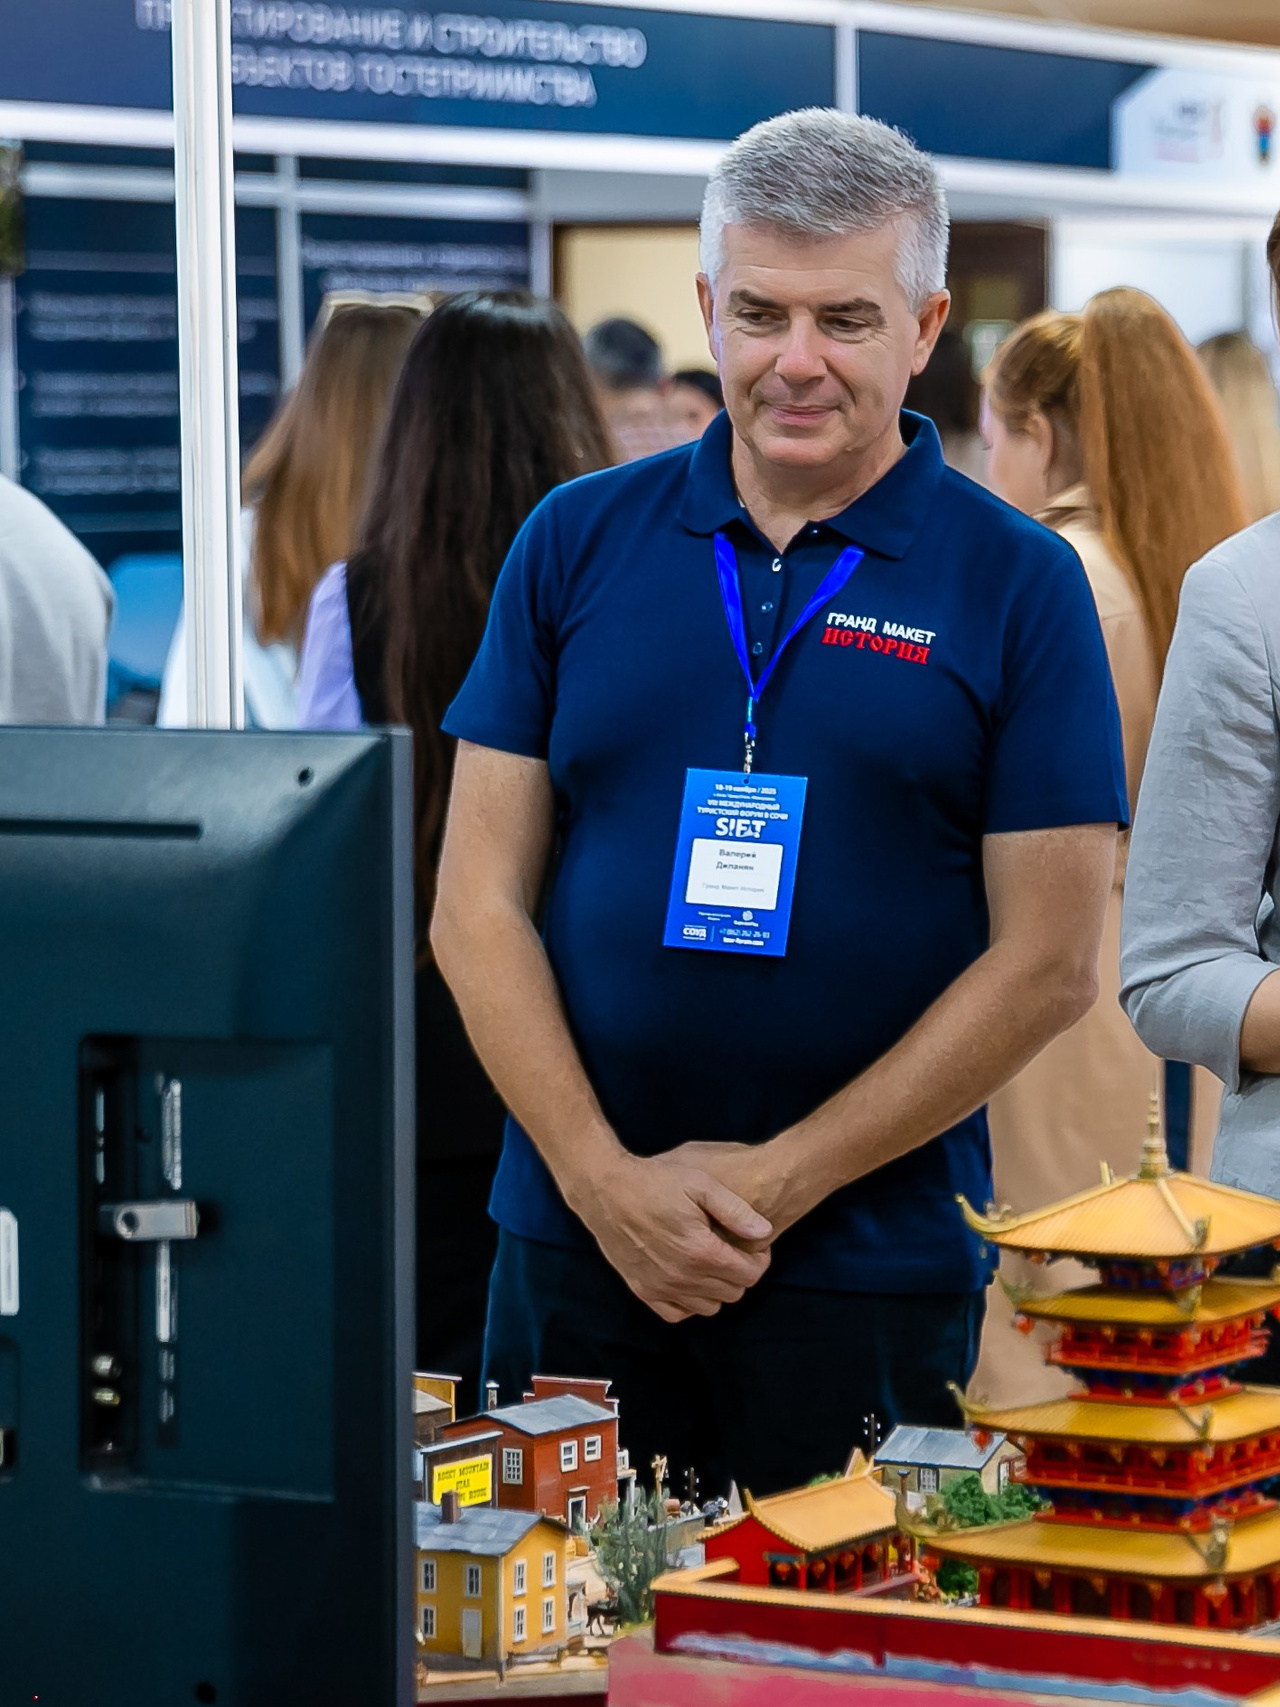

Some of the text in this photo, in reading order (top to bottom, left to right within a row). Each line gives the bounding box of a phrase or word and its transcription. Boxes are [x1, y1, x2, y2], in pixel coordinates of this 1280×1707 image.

[821, 626, 931, 665] ИСТОРИЯ
[826, 612, 937, 645] ГРАНД МАКЕТ
